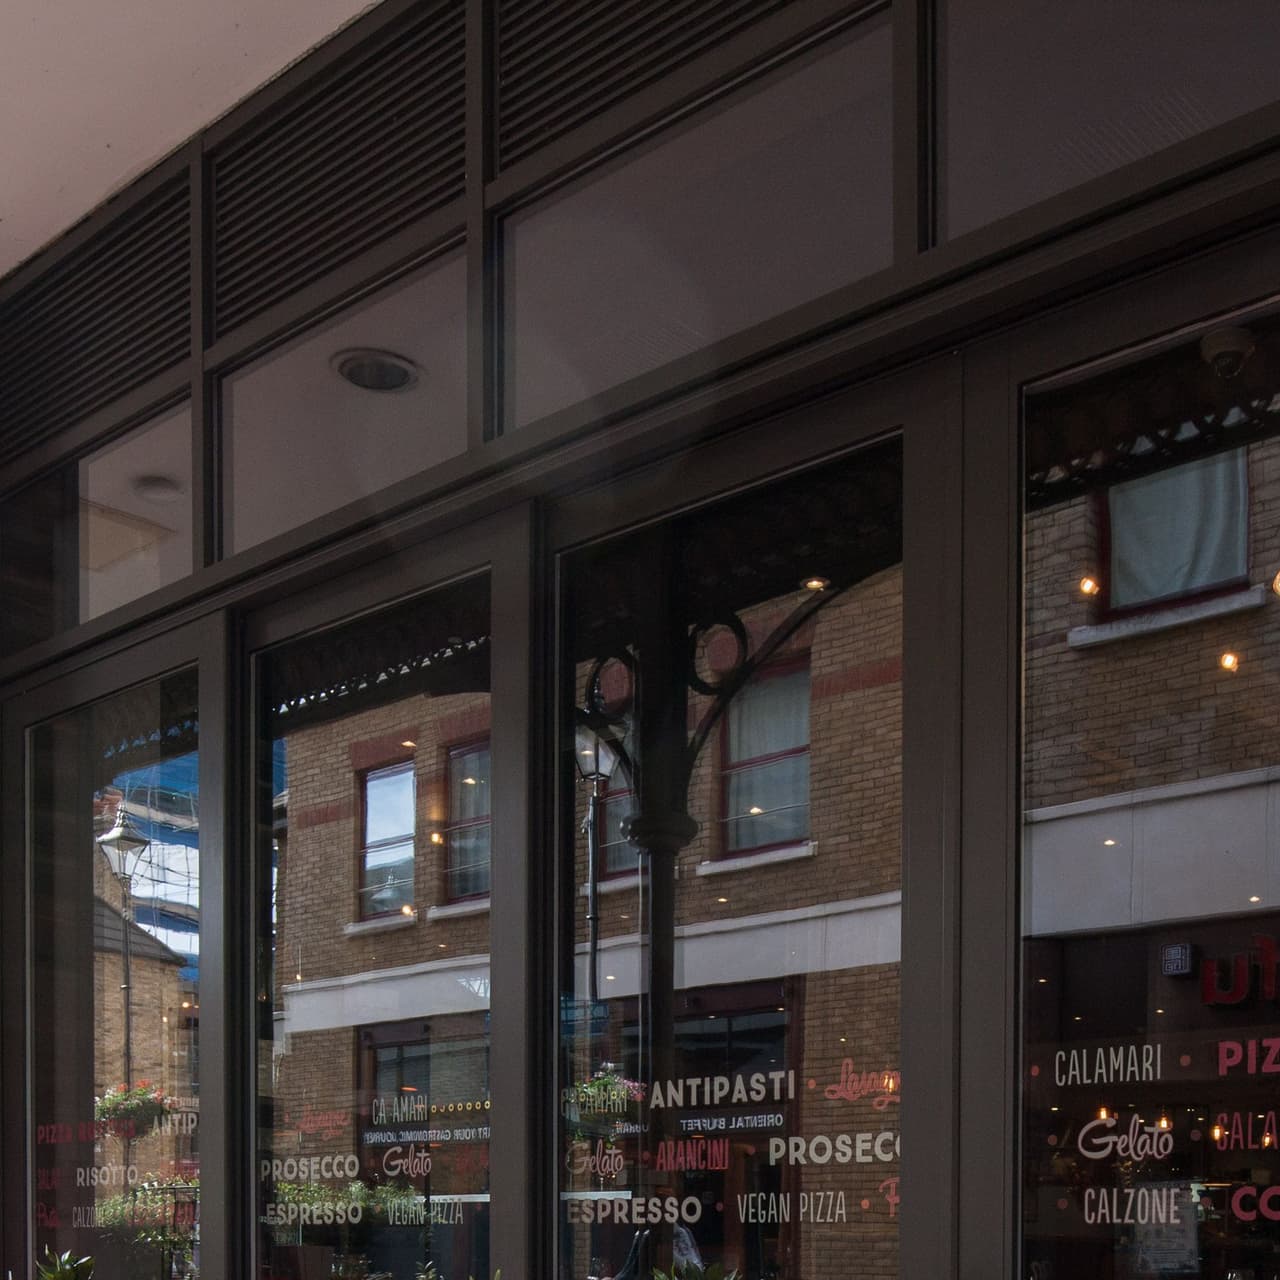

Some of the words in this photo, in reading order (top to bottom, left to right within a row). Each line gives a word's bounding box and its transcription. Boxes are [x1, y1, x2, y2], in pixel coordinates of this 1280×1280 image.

[1055, 1043, 1162, 1087] CALAMARI
[650, 1070, 796, 1109] ANTIPASTI
[372, 1094, 428, 1126] CAAMARI
[565, 1138, 625, 1177] Gelato
[656, 1138, 730, 1171] ARANCINI
[769, 1131, 901, 1166] PROSEC
[1077, 1112, 1174, 1162] Gelato
[76, 1164, 138, 1187] RISOTTO
[261, 1154, 360, 1181] PROSECCO
[382, 1144, 432, 1178] Gelato
[266, 1201, 363, 1225] ESPRESSO
[387, 1200, 426, 1225] VEGAN
[567, 1195, 702, 1224] ESPRESSO
[737, 1193, 790, 1224] VEGAN
[800, 1191, 847, 1223] PIZZA
[1083, 1186, 1182, 1225] CALZONE
